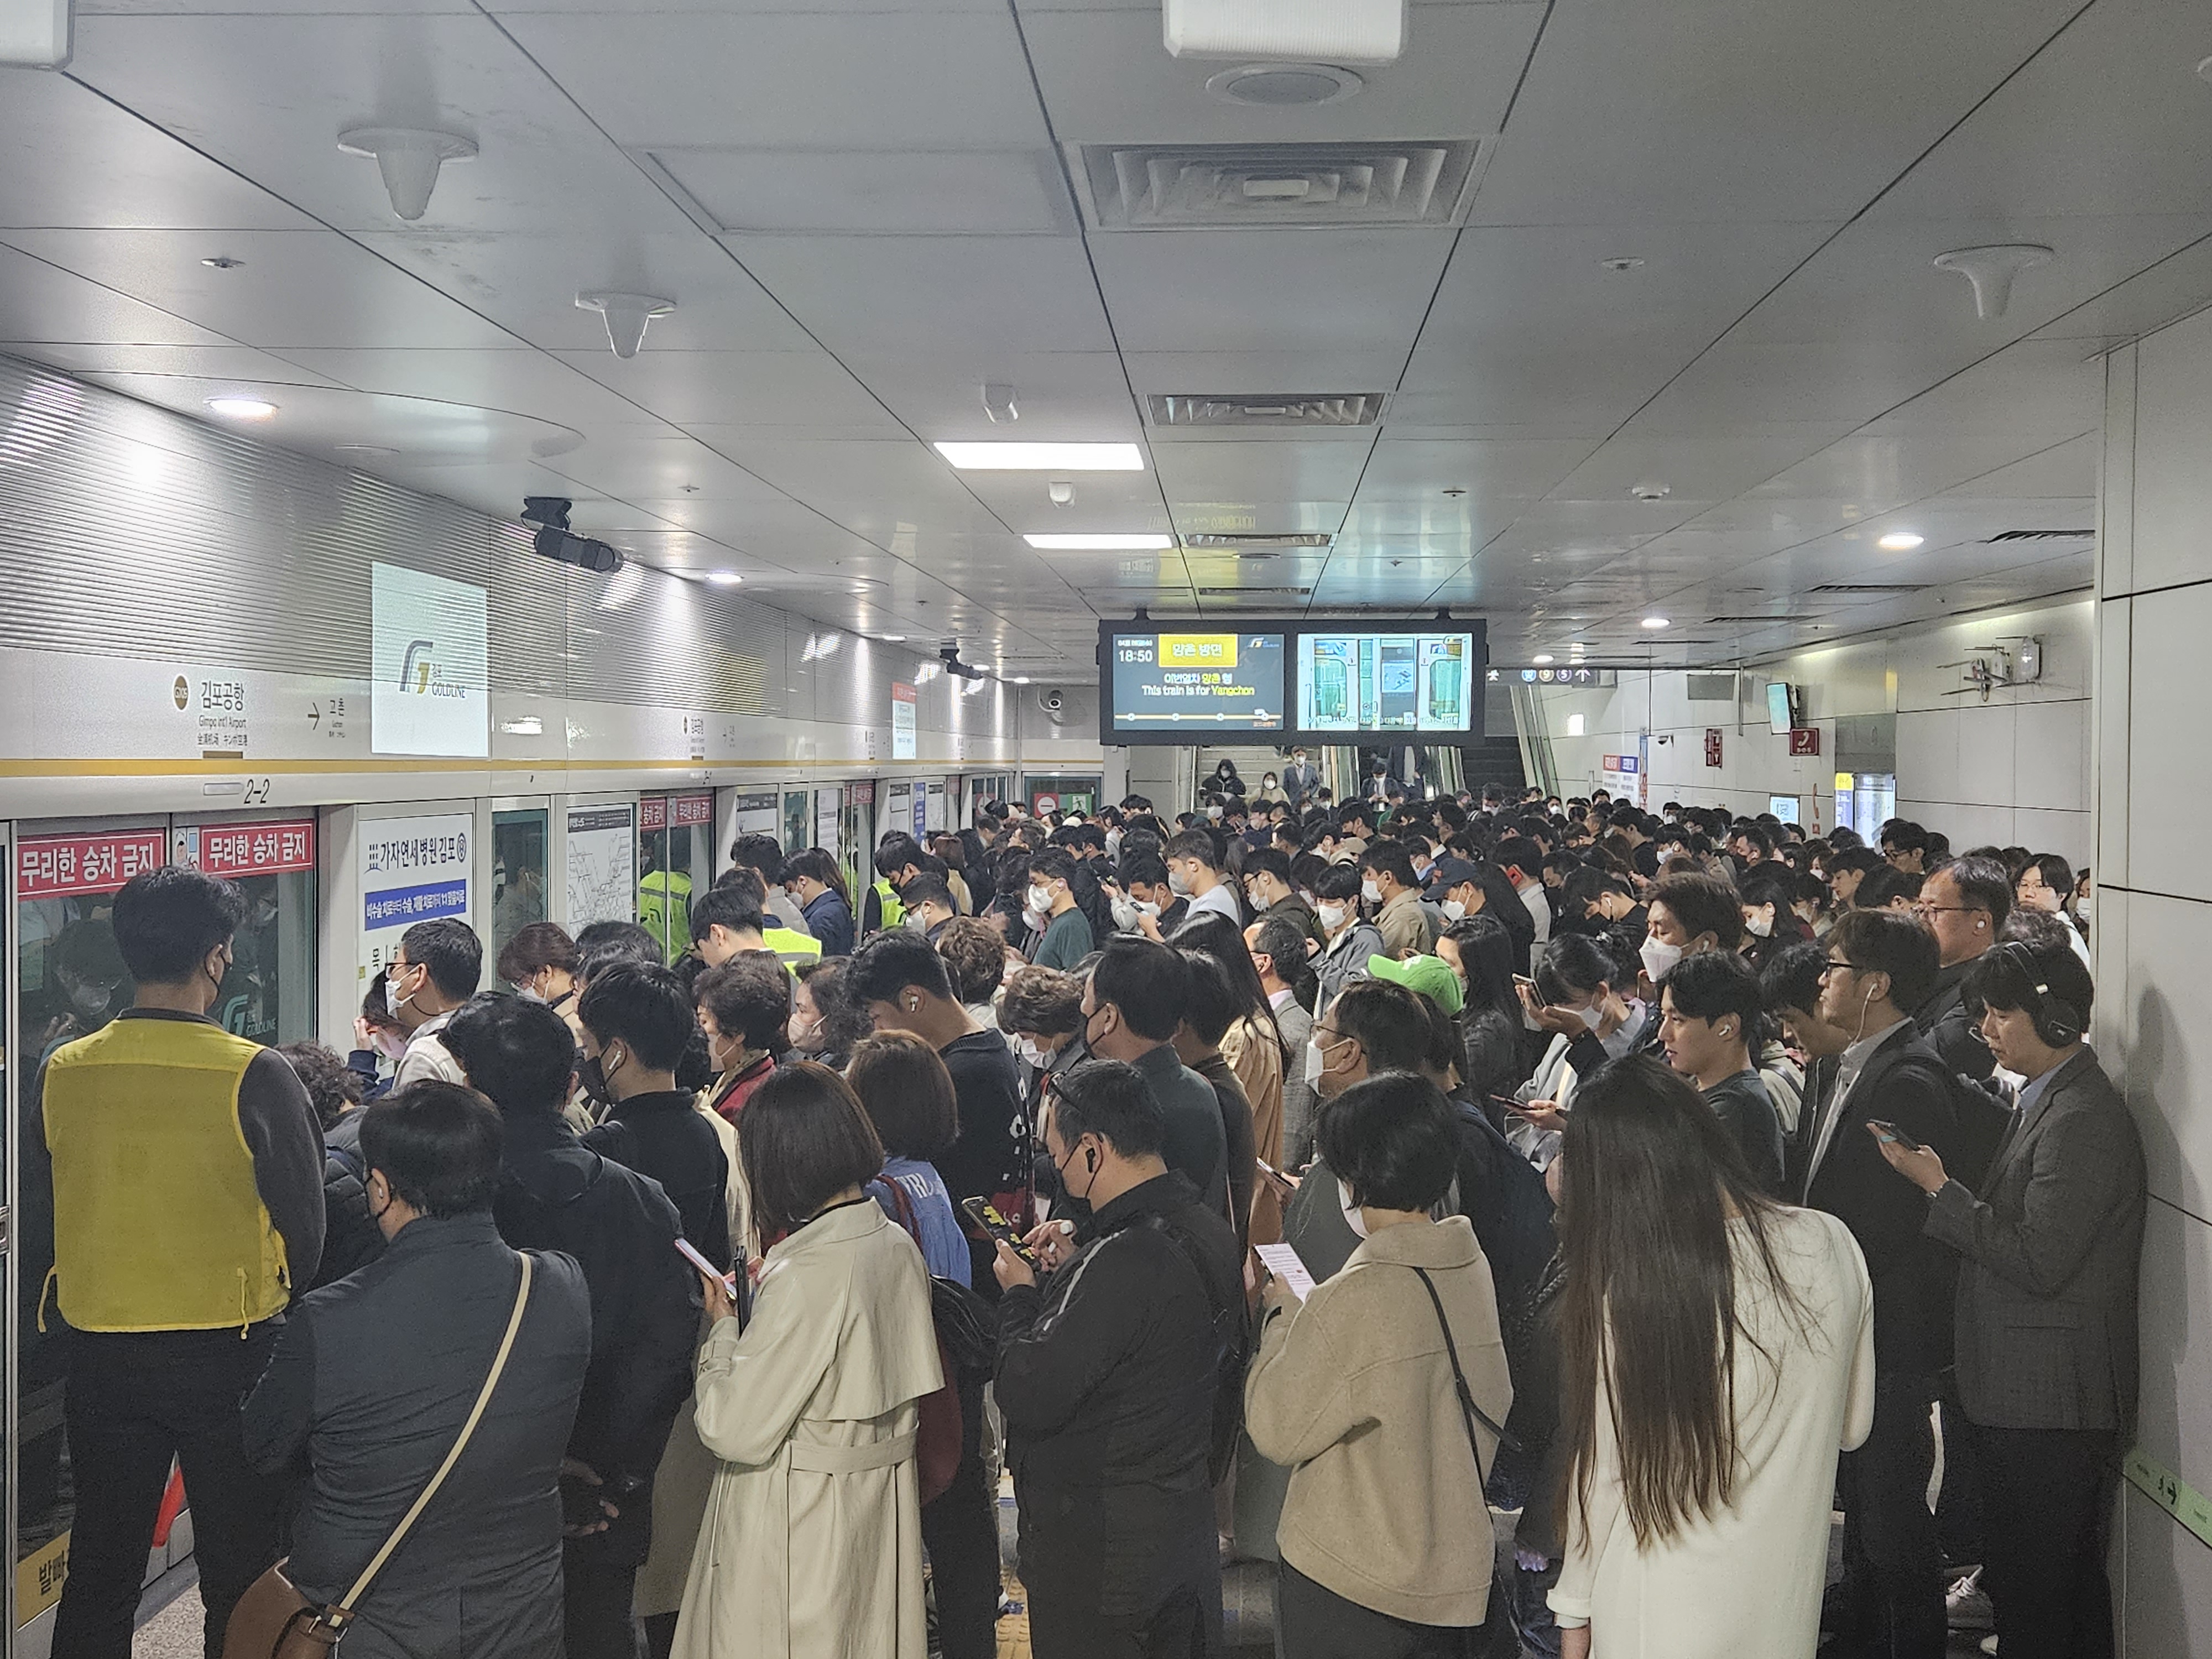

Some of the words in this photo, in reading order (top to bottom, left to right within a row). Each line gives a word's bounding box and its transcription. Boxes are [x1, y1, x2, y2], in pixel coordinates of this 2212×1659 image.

[1119, 649, 1153, 662] 18:50
[201, 680, 244, 711] 김포공항
[432, 681, 466, 698] GOLDLINE
[1141, 685, 1161, 696] This
[1162, 685, 1185, 696] train
[1186, 685, 1193, 696] is
[1195, 685, 1211, 696] for
[1211, 685, 1255, 697] Yangchon
[330, 698, 345, 717] 고촌
[199, 714, 217, 729] Gimpo
[228, 716, 247, 730] Airport
[243, 778, 270, 804] 2-2
[210, 834, 250, 868] 무리한
[253, 833, 279, 864] 승차
[282, 831, 305, 861] 금지
[380, 837, 437, 870] 가자연세병원
[439, 836, 456, 864] 김포
[21, 847, 76, 886] 무리한
[82, 845, 116, 881] 승차
[122, 842, 154, 877] 금지
